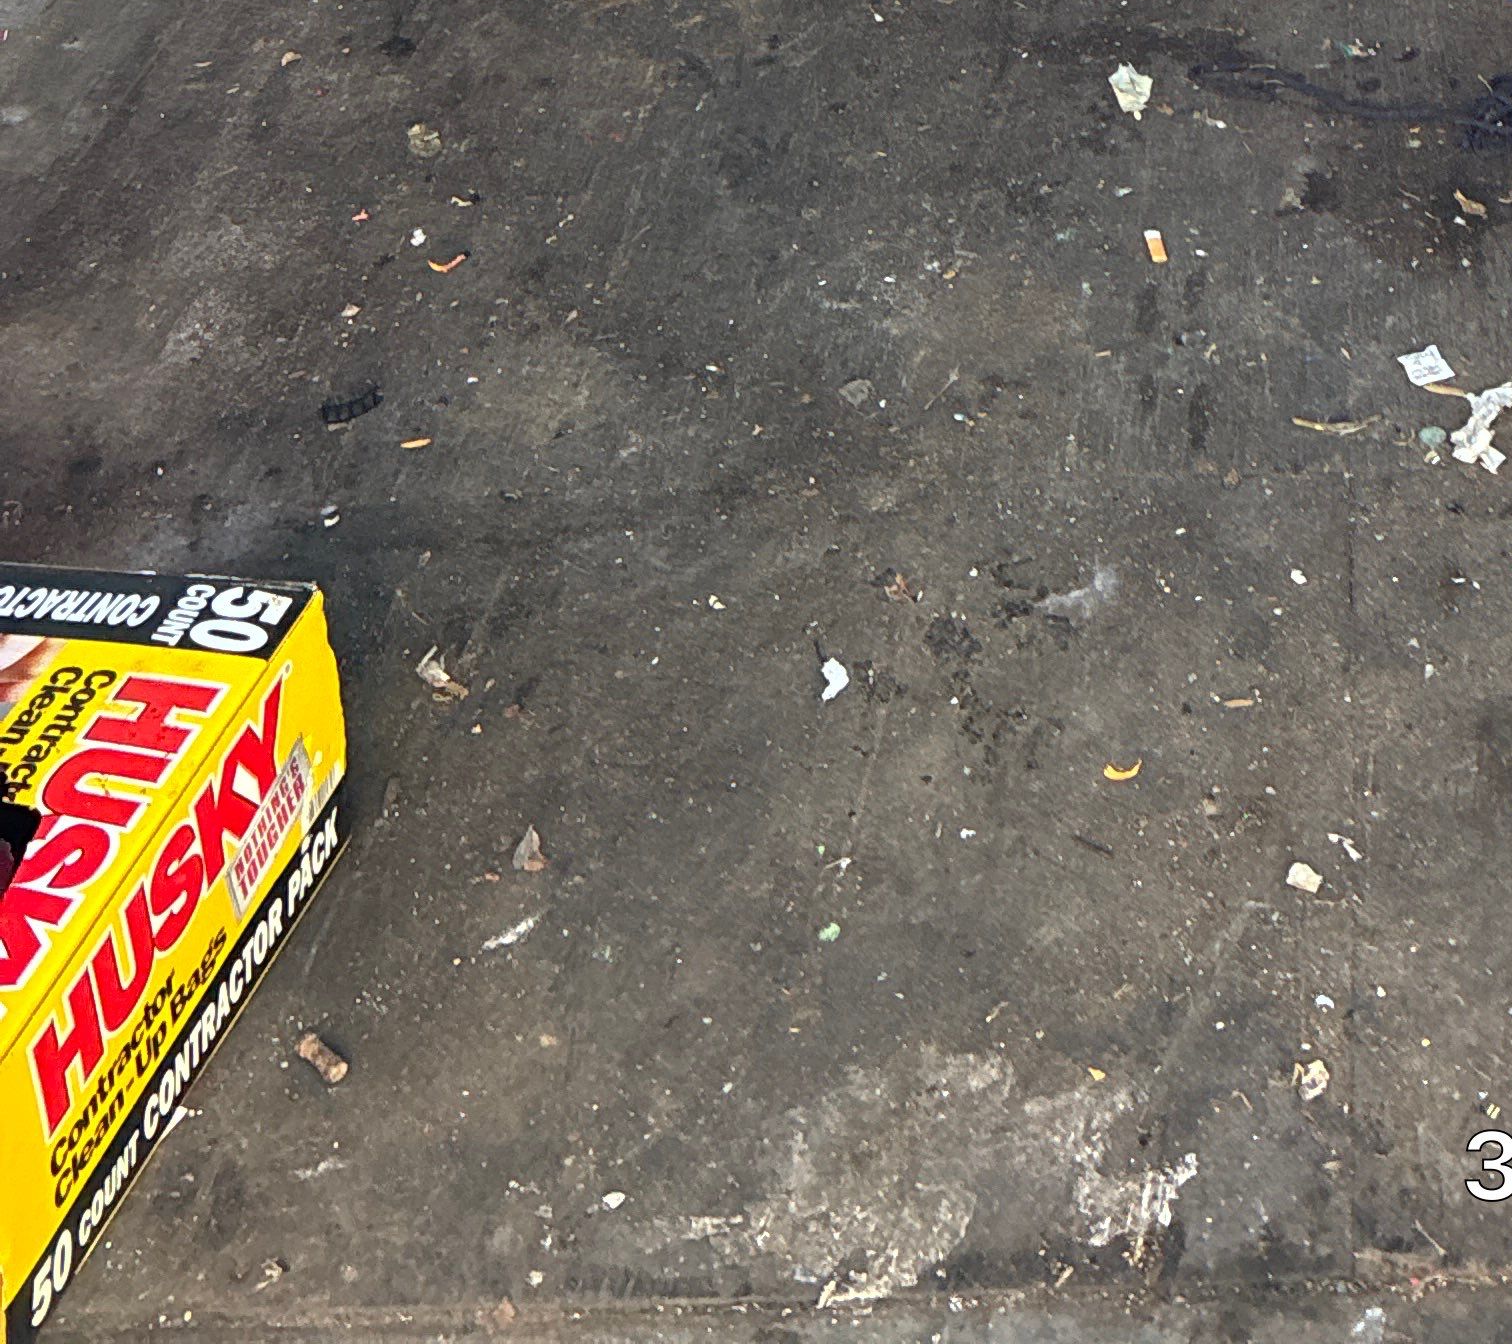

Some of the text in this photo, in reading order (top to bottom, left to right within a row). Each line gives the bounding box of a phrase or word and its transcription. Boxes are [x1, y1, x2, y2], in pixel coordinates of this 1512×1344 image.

[151, 583, 209, 647] COUNT
[189, 585, 294, 653] 50
[28, 668, 286, 1143] HUSKY
[238, 771, 306, 900] TOUGHER
[30, 806, 338, 1328] 50 COUNT CONTRACTOR PACK
[50, 966, 176, 1177] Contractor
[54, 925, 228, 1209] Clean-Up Bags
